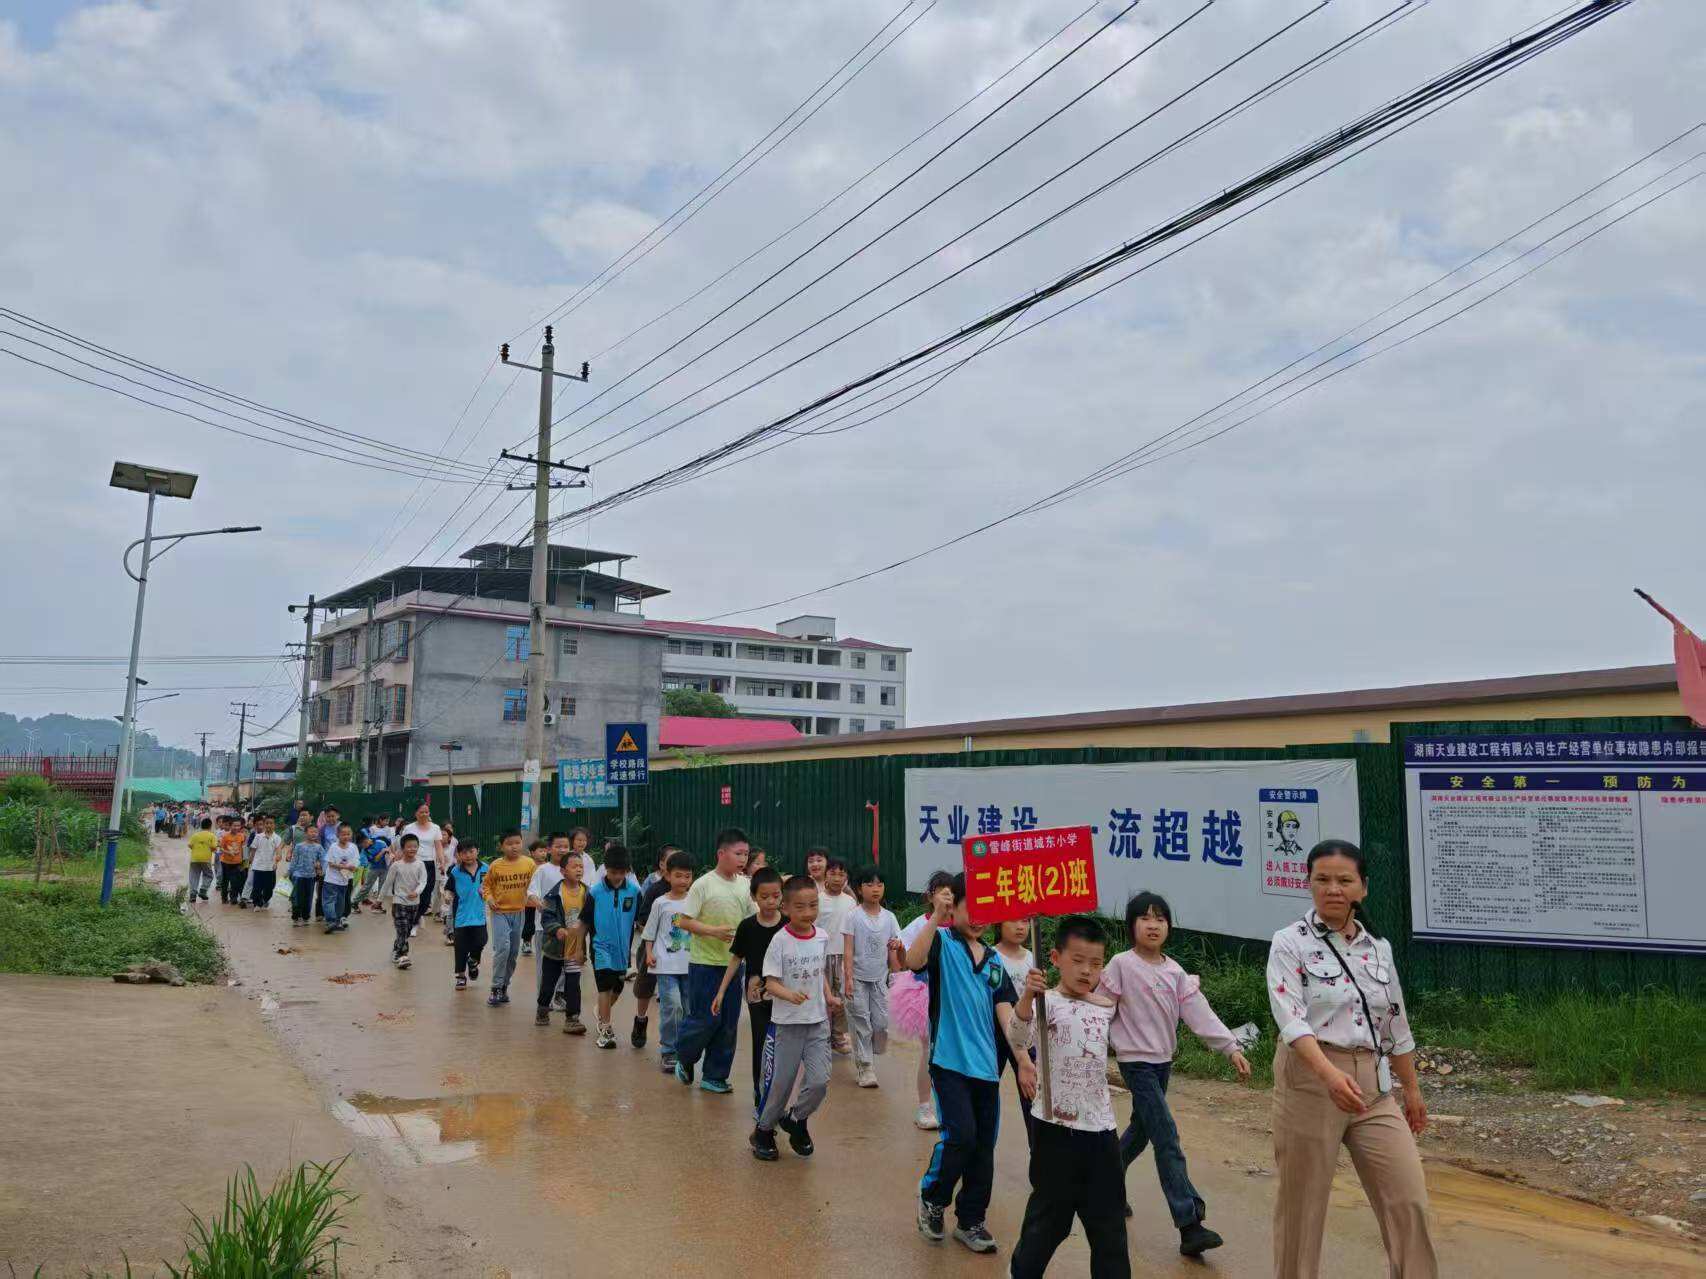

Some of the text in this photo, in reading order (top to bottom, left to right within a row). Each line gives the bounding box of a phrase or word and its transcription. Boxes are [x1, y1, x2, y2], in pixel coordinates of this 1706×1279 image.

[609, 758, 645, 769] 学校路段
[1449, 775, 1686, 789] 安全第一 预防为
[1268, 790, 1307, 800] 安全警示牌
[919, 804, 1244, 867] 天业建设 流超越
[1266, 809, 1274, 847] 安全第一
[988, 833, 1078, 854] 雪峰街道城东小学
[975, 857, 1090, 906] 二年级(2)班
[1266, 875, 1312, 890] 必须做好安全
